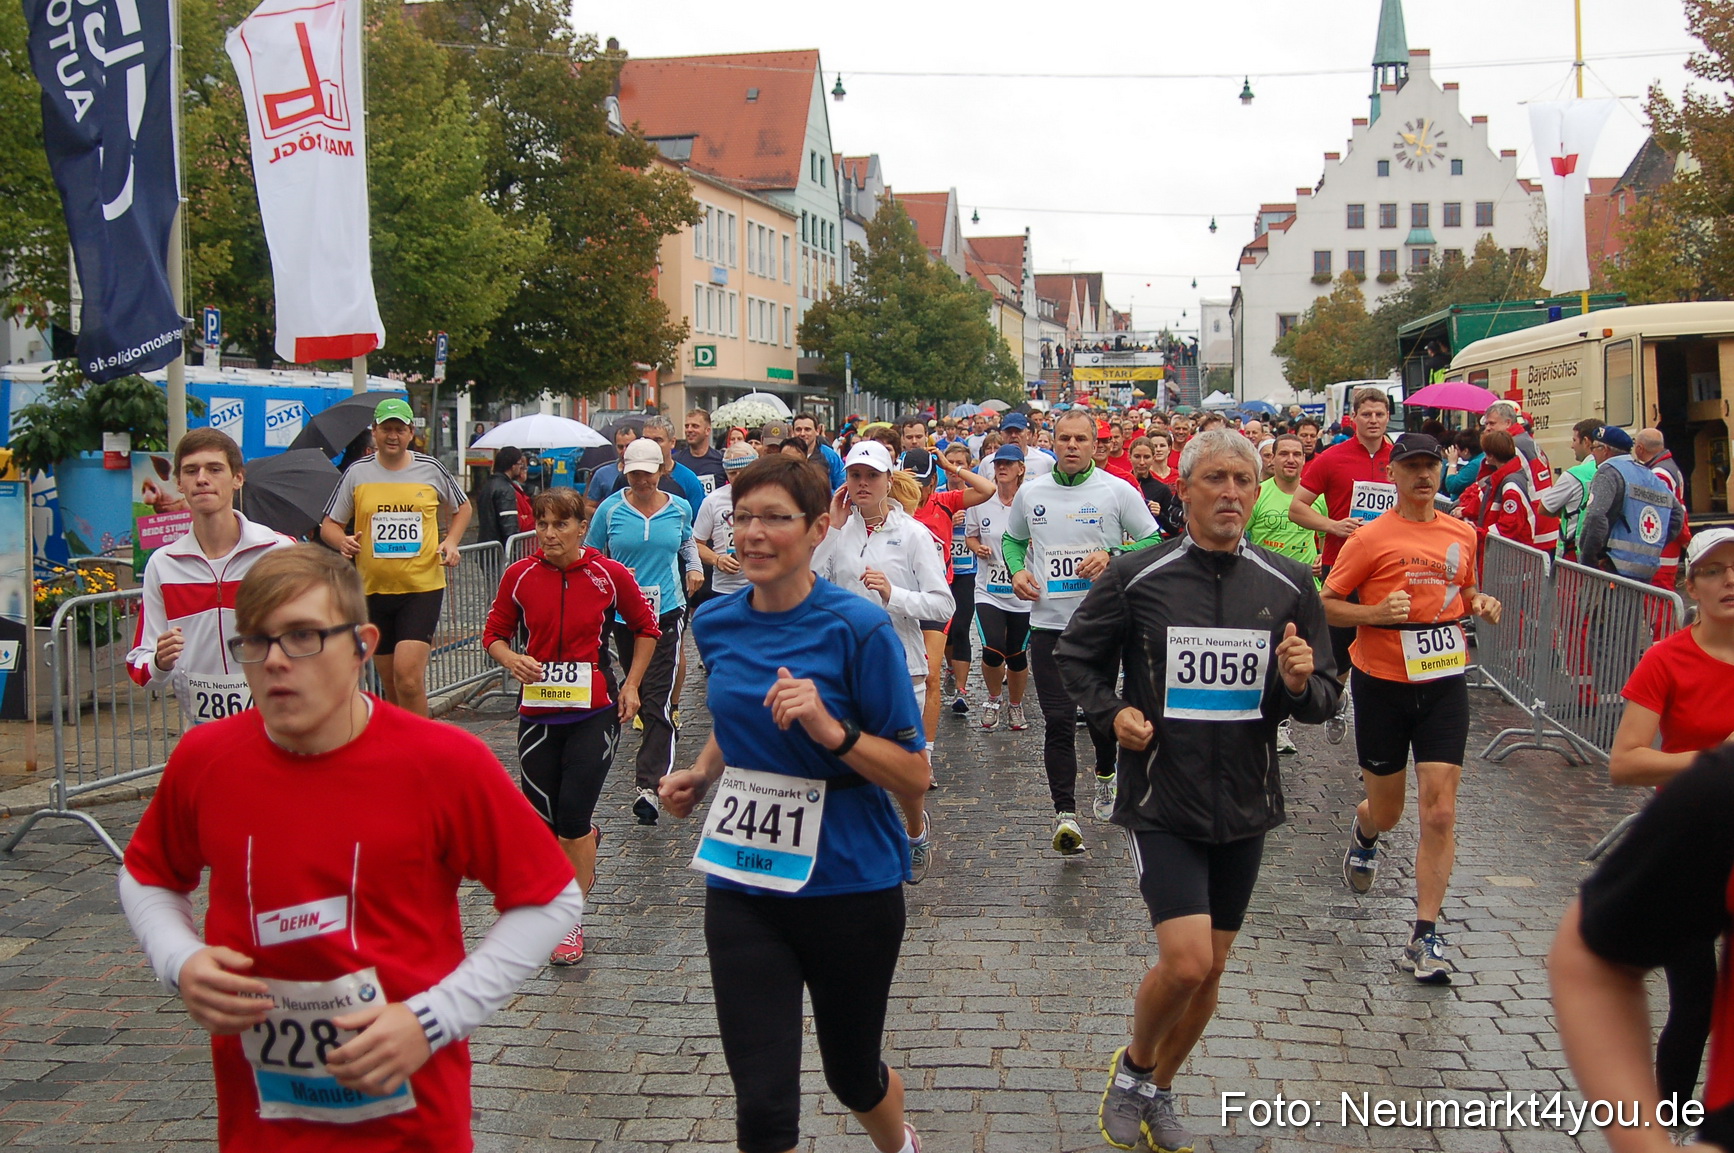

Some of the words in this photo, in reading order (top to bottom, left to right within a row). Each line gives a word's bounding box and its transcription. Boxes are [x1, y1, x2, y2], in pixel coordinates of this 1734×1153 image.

[207, 313, 217, 341] P
[697, 348, 713, 364] D
[1103, 370, 1133, 378] START
[1528, 359, 1578, 386] Bayerisches
[1527, 388, 1551, 407] Rotes
[1531, 413, 1550, 430] reuz
[377, 504, 414, 513] FRANK
[1356, 491, 1395, 510] 2098
[377, 523, 418, 540] 2266
[388, 544, 407, 552] Frank
[1064, 548, 1093, 556] Neumarkt
[1411, 557, 1429, 566] Mai
[1431, 560, 1453, 573] 2008
[1062, 580, 1087, 591] Martin
[1408, 577, 1446, 586] Marathon
[1169, 636, 1203, 646] PARTL
[1205, 638, 1252, 648] Neumarkt
[1416, 627, 1456, 655] 503
[1177, 650, 1259, 685] 3058
[1421, 656, 1459, 670] Bernhard
[189, 680, 212, 689] PARTL
[212, 681, 249, 690] Neumark
[540, 689, 571, 699] Renate
[721, 778, 747, 791] PARTL
[749, 783, 801, 800] Neumarkt
[715, 795, 805, 848] 2441
[736, 850, 773, 871] Erika
[279, 911, 321, 933] DEHN
[281, 994, 353, 1011] Neumarkt
[253, 1018, 366, 1069] 228
